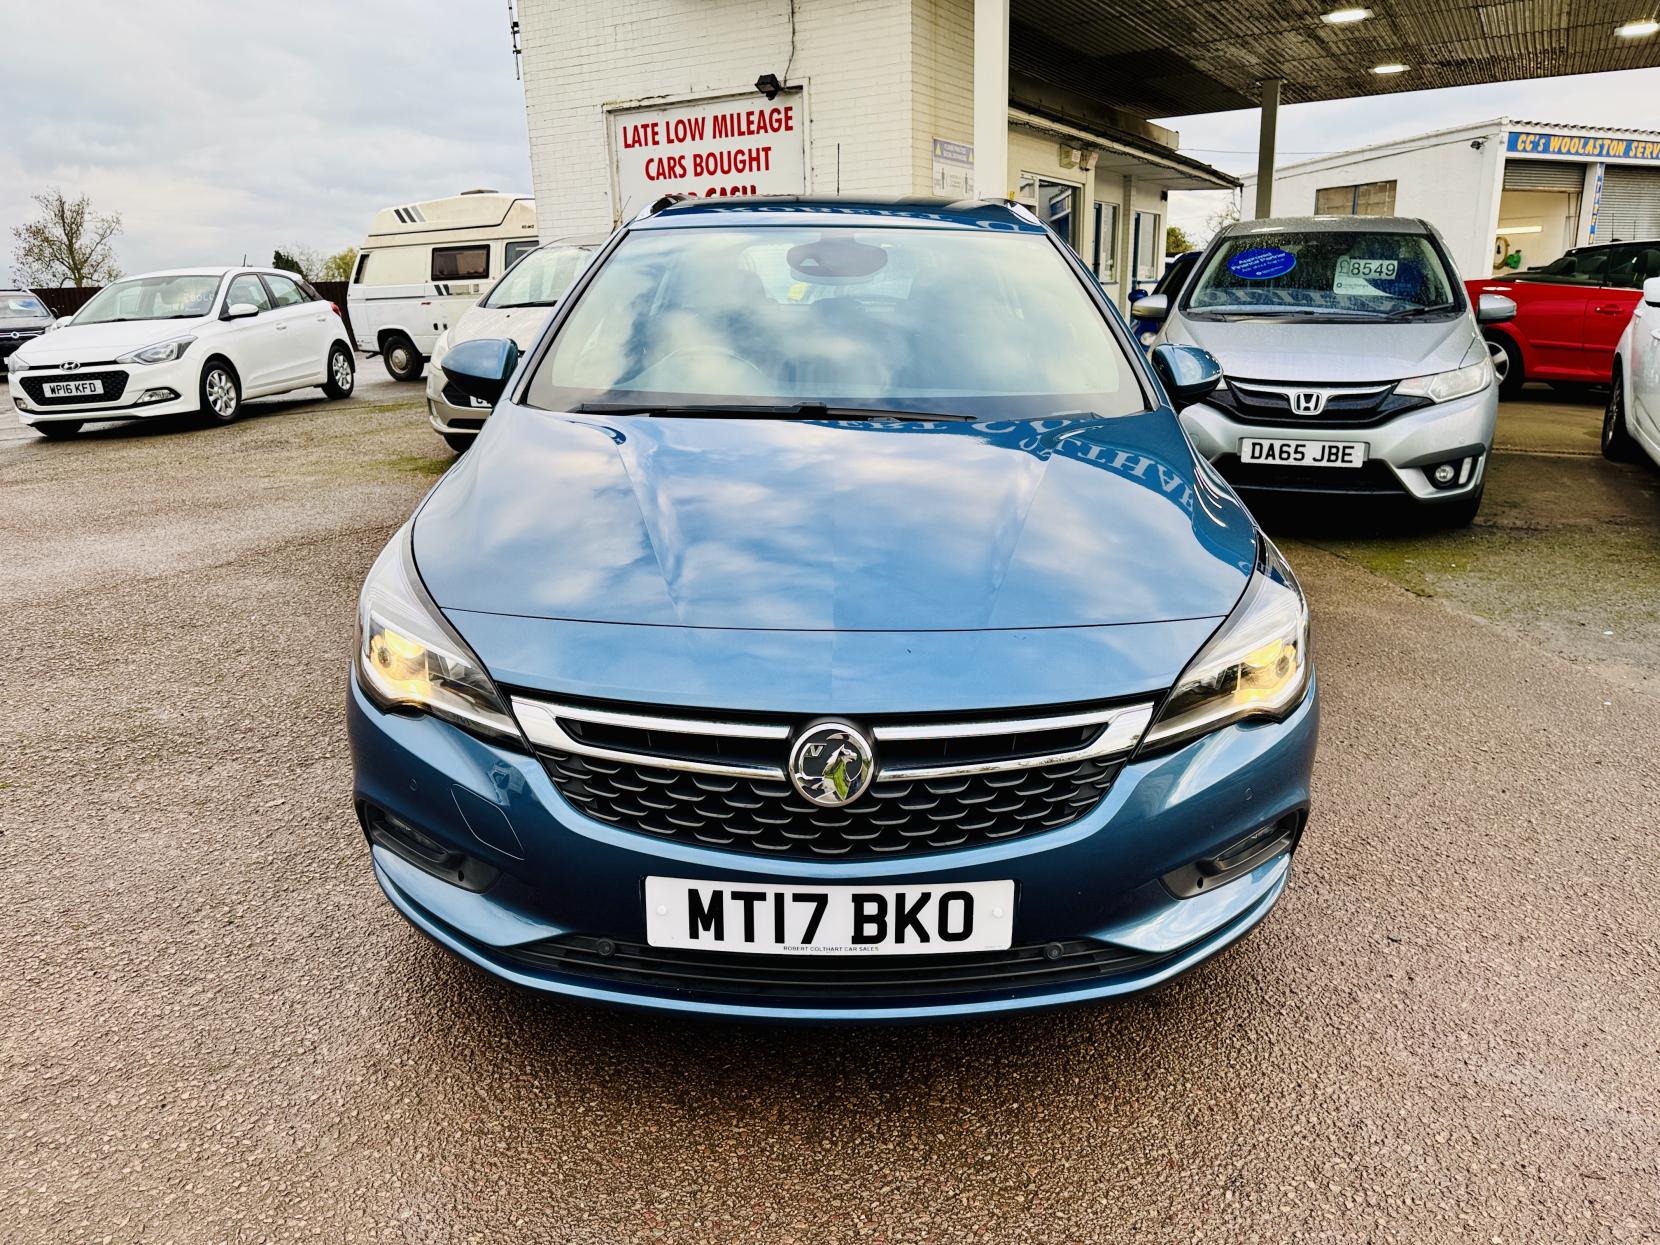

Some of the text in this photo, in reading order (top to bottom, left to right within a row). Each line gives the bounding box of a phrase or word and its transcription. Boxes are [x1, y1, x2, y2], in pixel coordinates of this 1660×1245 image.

[622, 106, 794, 149] LATE LOW MILEAGE
[1516, 133, 1660, 158] CC's WOOLASTON SERV
[645, 146, 772, 181] CARS BOUGHT
[1338, 260, 1397, 277] £8549
[49, 382, 97, 396] WP16 KFD
[1250, 441, 1355, 464] DA65 JBE
[687, 888, 975, 945] MT17 BKO
